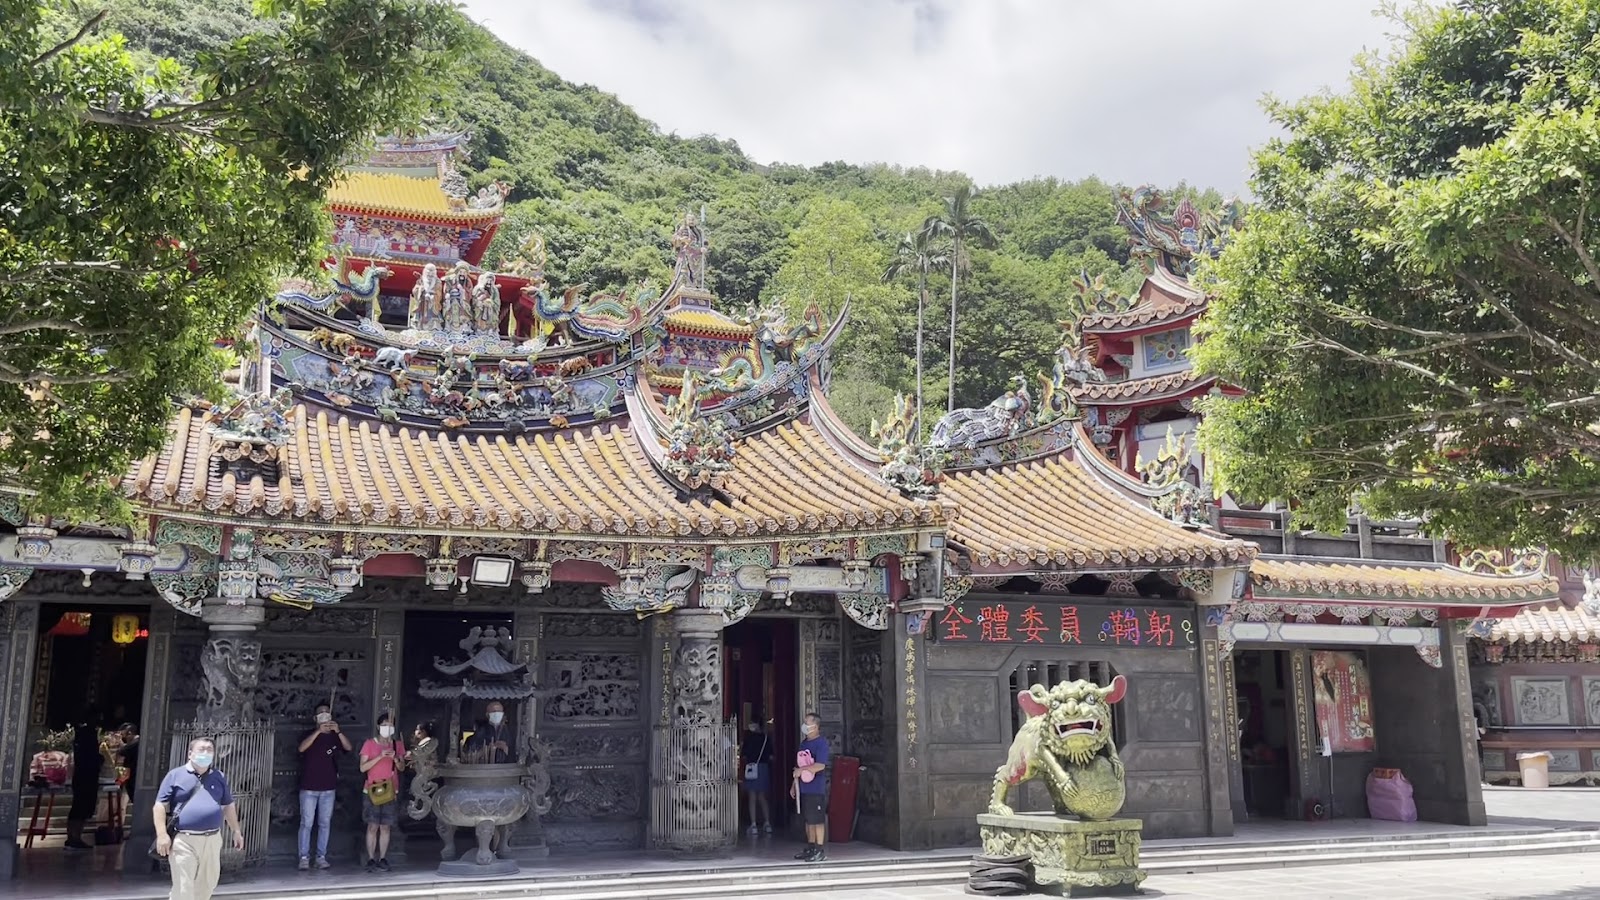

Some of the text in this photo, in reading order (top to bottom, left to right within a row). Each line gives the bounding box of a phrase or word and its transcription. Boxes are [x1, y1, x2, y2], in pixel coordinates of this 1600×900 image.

[939, 604, 1175, 646] 全體委員 鞠躬
